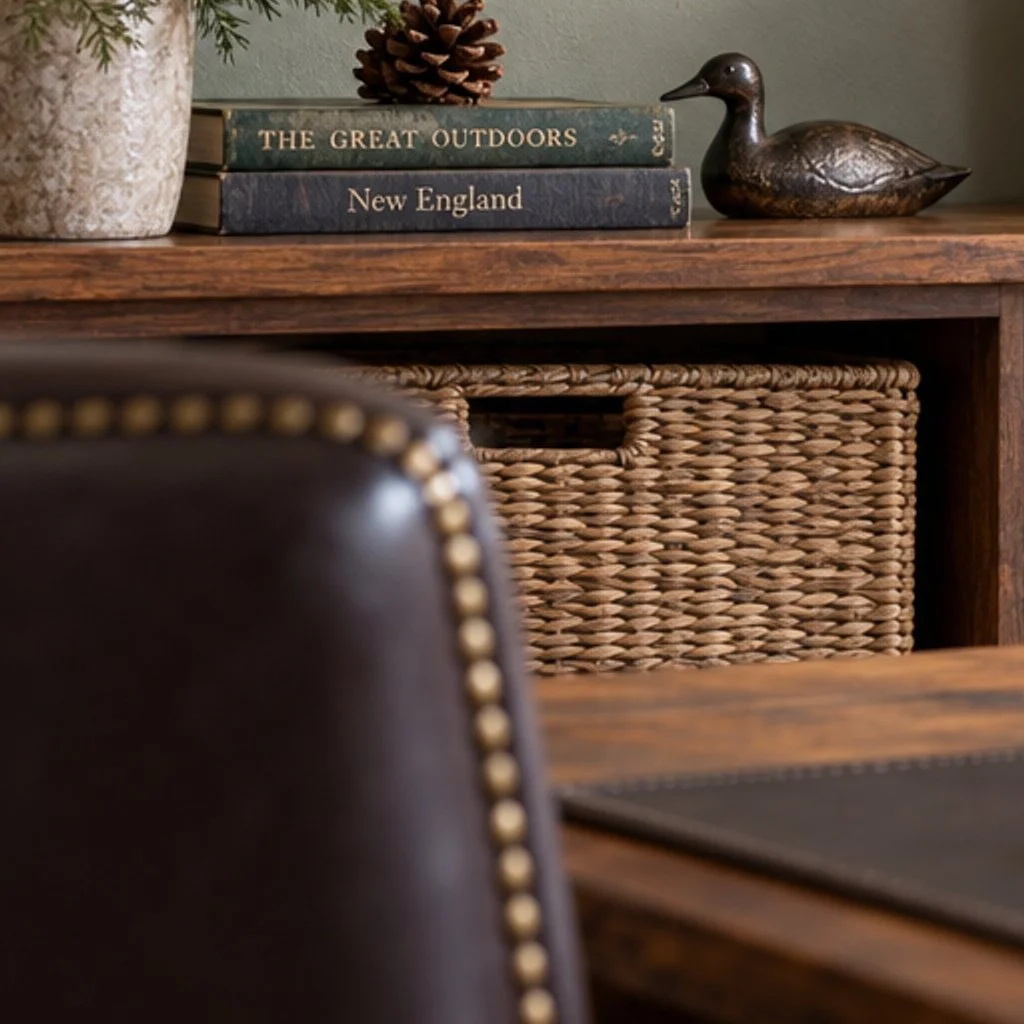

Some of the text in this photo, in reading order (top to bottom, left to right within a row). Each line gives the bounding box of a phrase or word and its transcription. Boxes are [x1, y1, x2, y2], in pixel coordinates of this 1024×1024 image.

[258, 127, 578, 151] THE GREAT OUTDOORS
[347, 185, 523, 219] New England
